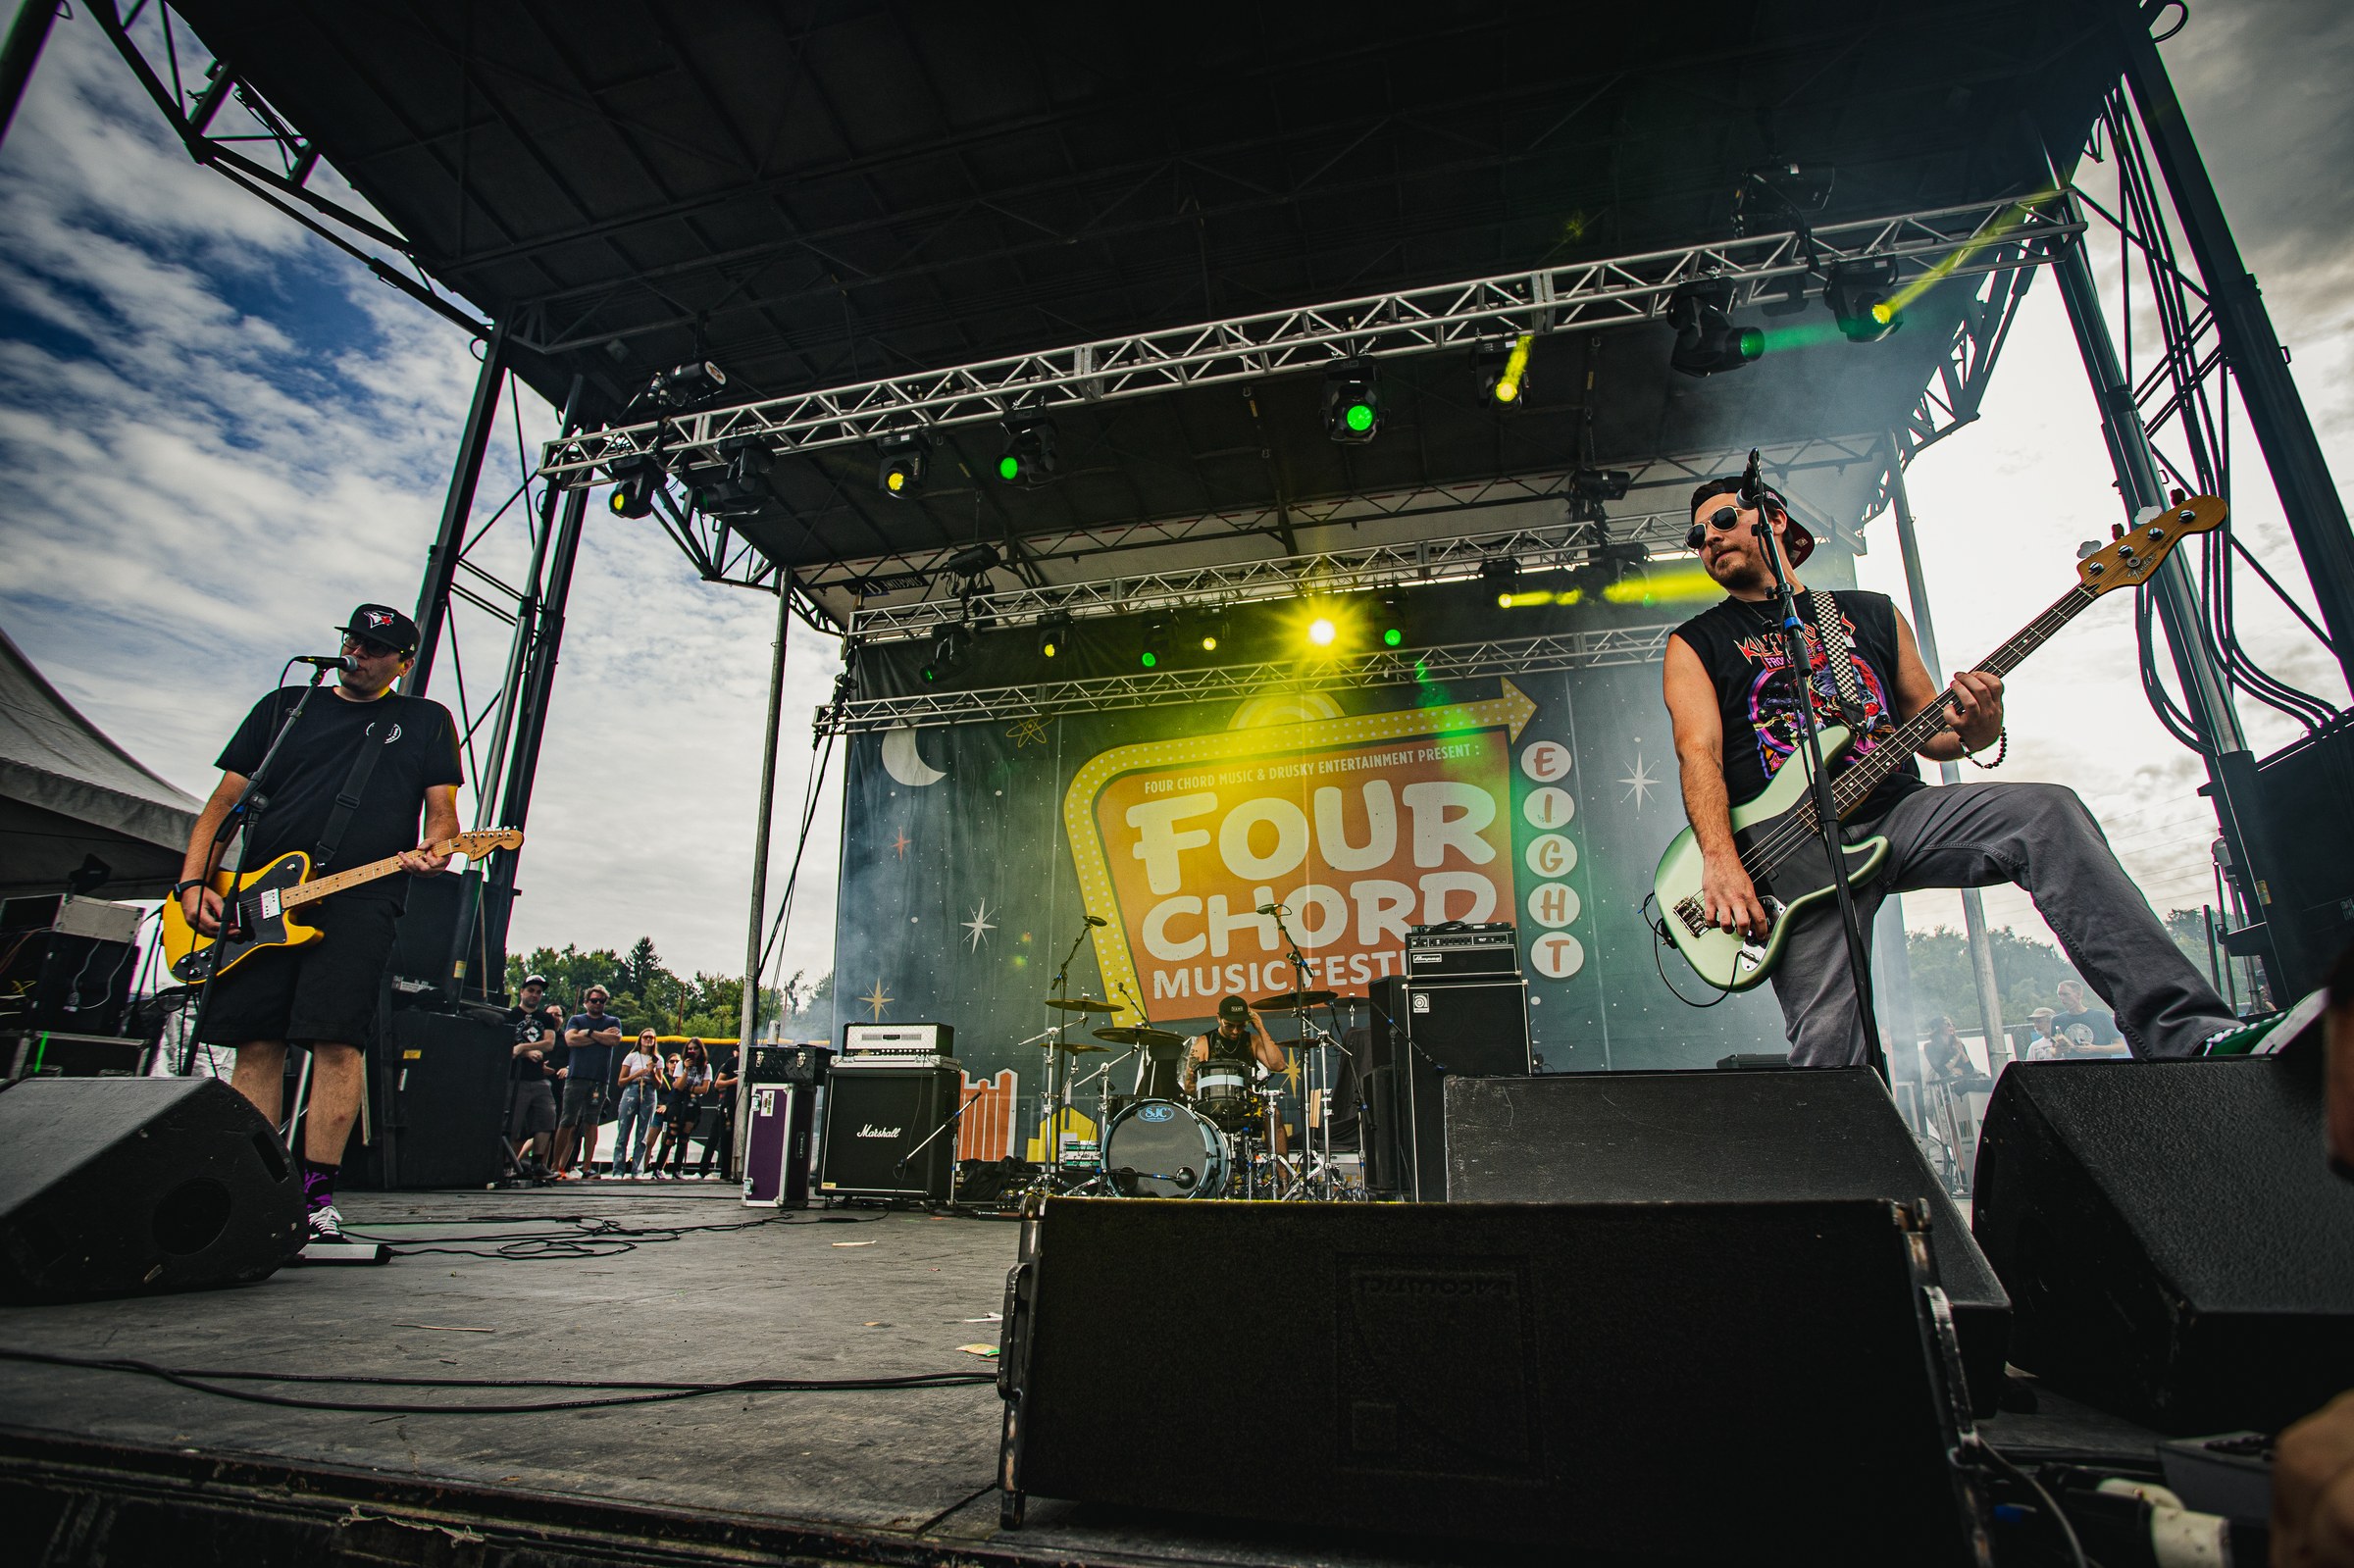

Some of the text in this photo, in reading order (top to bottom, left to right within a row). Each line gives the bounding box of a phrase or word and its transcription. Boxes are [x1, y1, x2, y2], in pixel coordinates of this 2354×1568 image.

[1145, 780, 1173, 794] FOUR
[1177, 776, 1215, 790] CHORD
[1219, 770, 1254, 784] MUSIC
[1256, 768, 1265, 782] &
[1269, 763, 1314, 780] DRUSKY
[1318, 750, 1413, 774] ENTERTAINMENT
[1125, 780, 1497, 895] FOUR
[1143, 871, 1498, 961] CHORD
[1153, 949, 1407, 1000] MUSIC FESTI
[856, 1124, 901, 1138] Marshall
[1145, 1107, 1167, 1118] SJC
